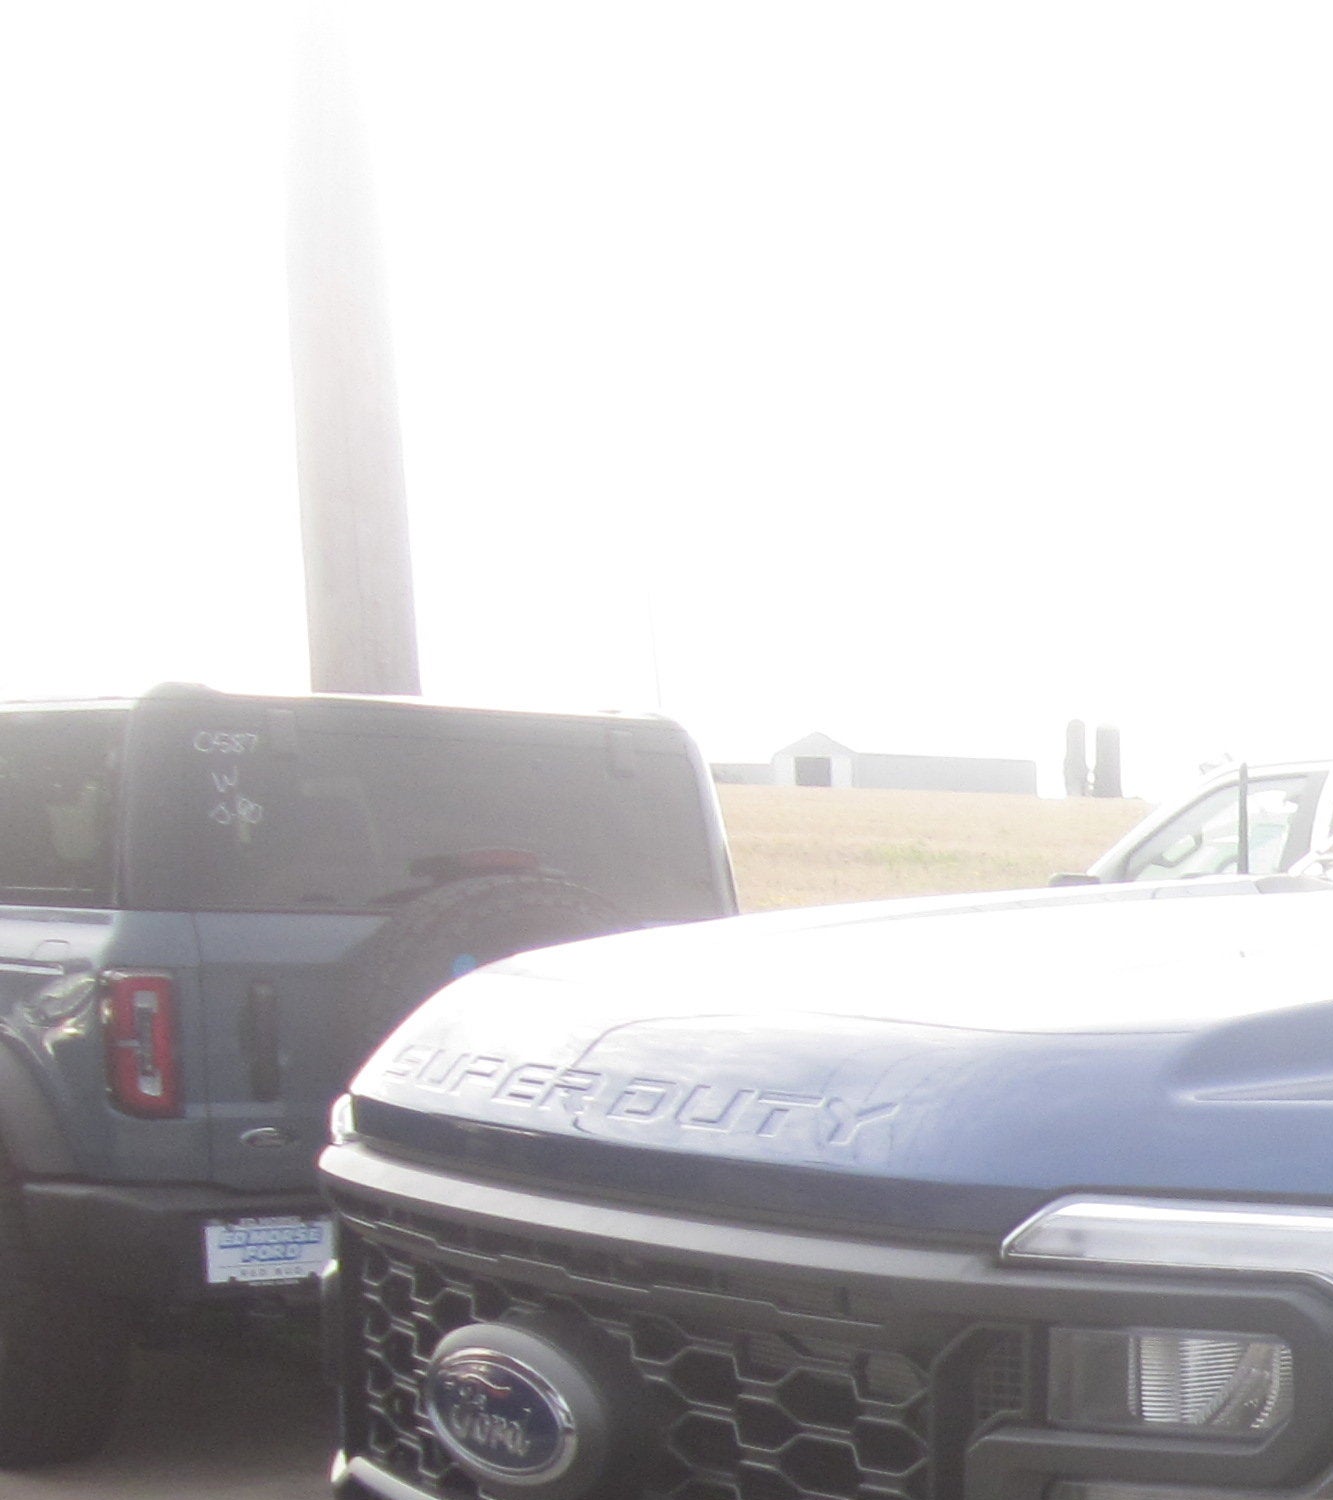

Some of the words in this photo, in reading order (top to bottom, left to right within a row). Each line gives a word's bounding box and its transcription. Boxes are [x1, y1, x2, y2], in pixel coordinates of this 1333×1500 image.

[385, 1043, 602, 1119] SUPER
[607, 1075, 900, 1147] DUTY
[242, 1244, 300, 1262] FORD
